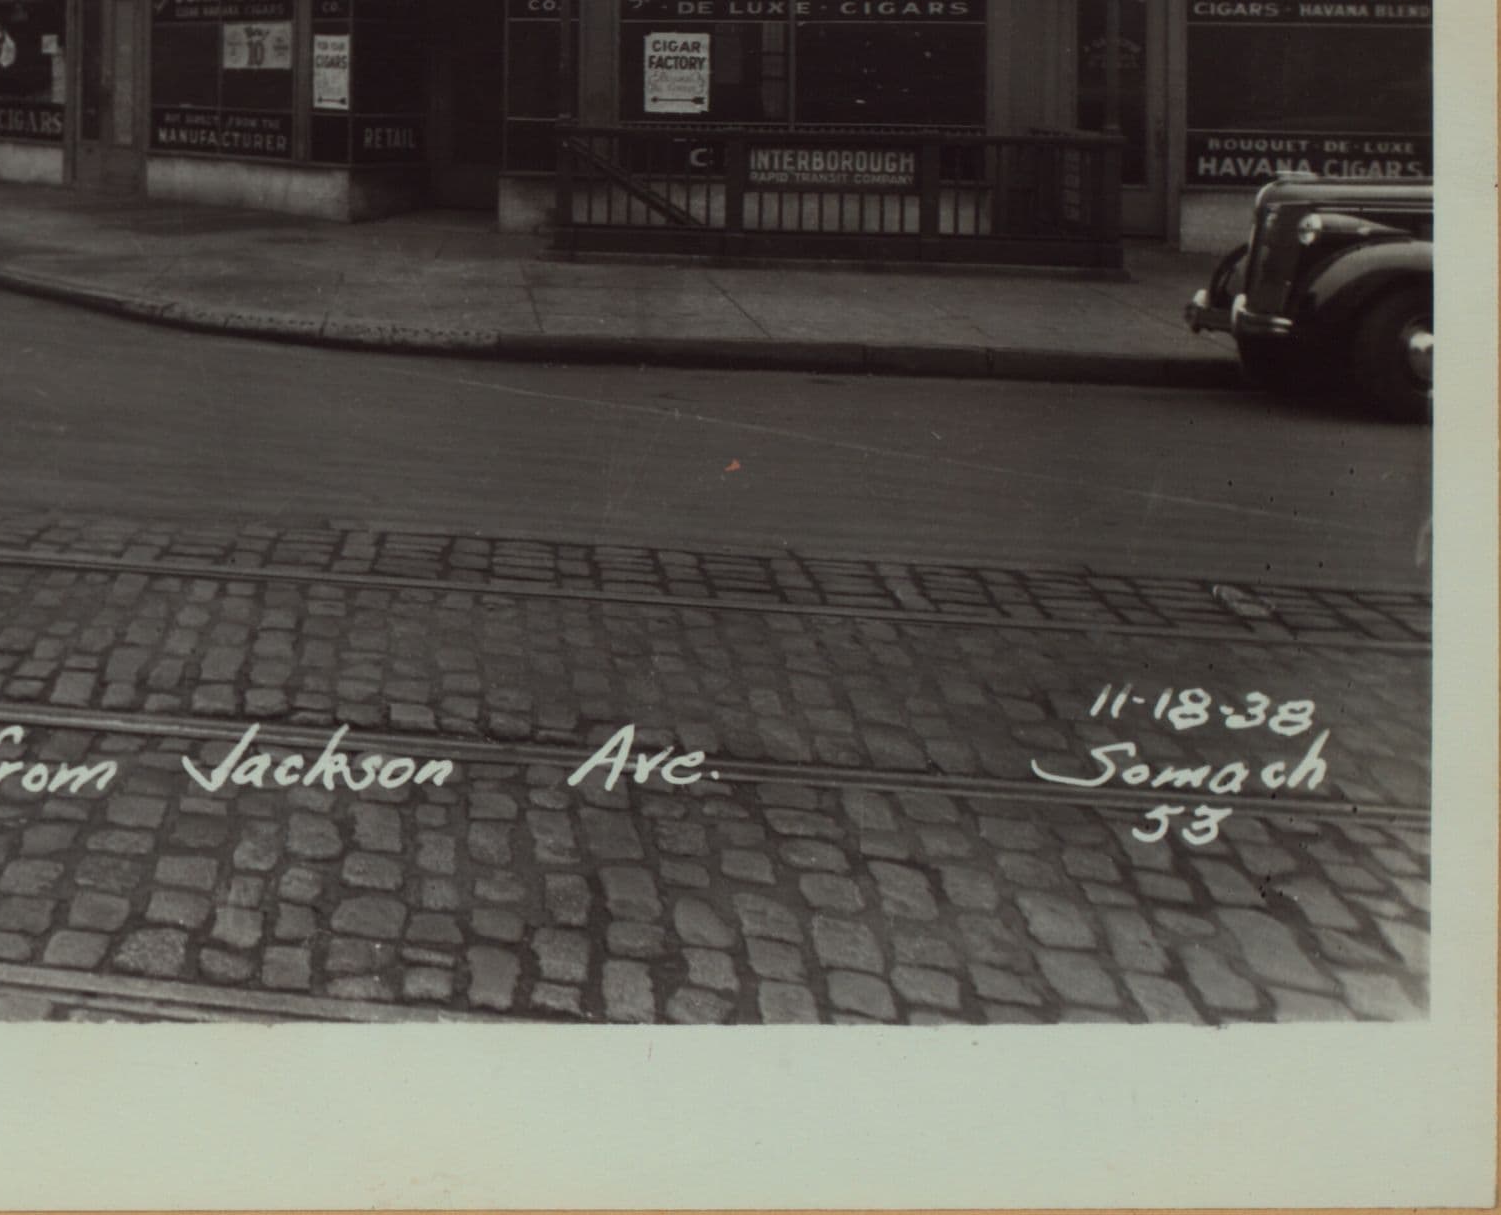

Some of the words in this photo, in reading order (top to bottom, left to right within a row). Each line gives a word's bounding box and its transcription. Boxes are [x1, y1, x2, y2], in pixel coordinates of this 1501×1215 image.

[676, 0, 714, 15] DE
[728, 0, 810, 15] LUXE
[839, 1, 971, 15] CIGARS
[1194, 1, 1280, 17] CIGARS
[1299, 3, 1369, 17] HAVANA
[652, 40, 702, 53] CIGAR
[648, 55, 707, 70] FACTORY
[158, 127, 287, 152] MANUFACTURER
[364, 127, 417, 148] RETAIL
[1207, 138, 1311, 152] BOUQUET
[1323, 140, 1350, 153] DE
[1362, 141, 1415, 154] LUXE
[749, 147, 916, 173] INTERBOROUGH
[1198, 156, 1314, 177] HAVANA
[1322, 158, 1425, 178] CIGARS
[749, 171, 789, 184] RAPID
[794, 173, 847, 184] TRANSIT
[853, 173, 915, 185] COMPANY
